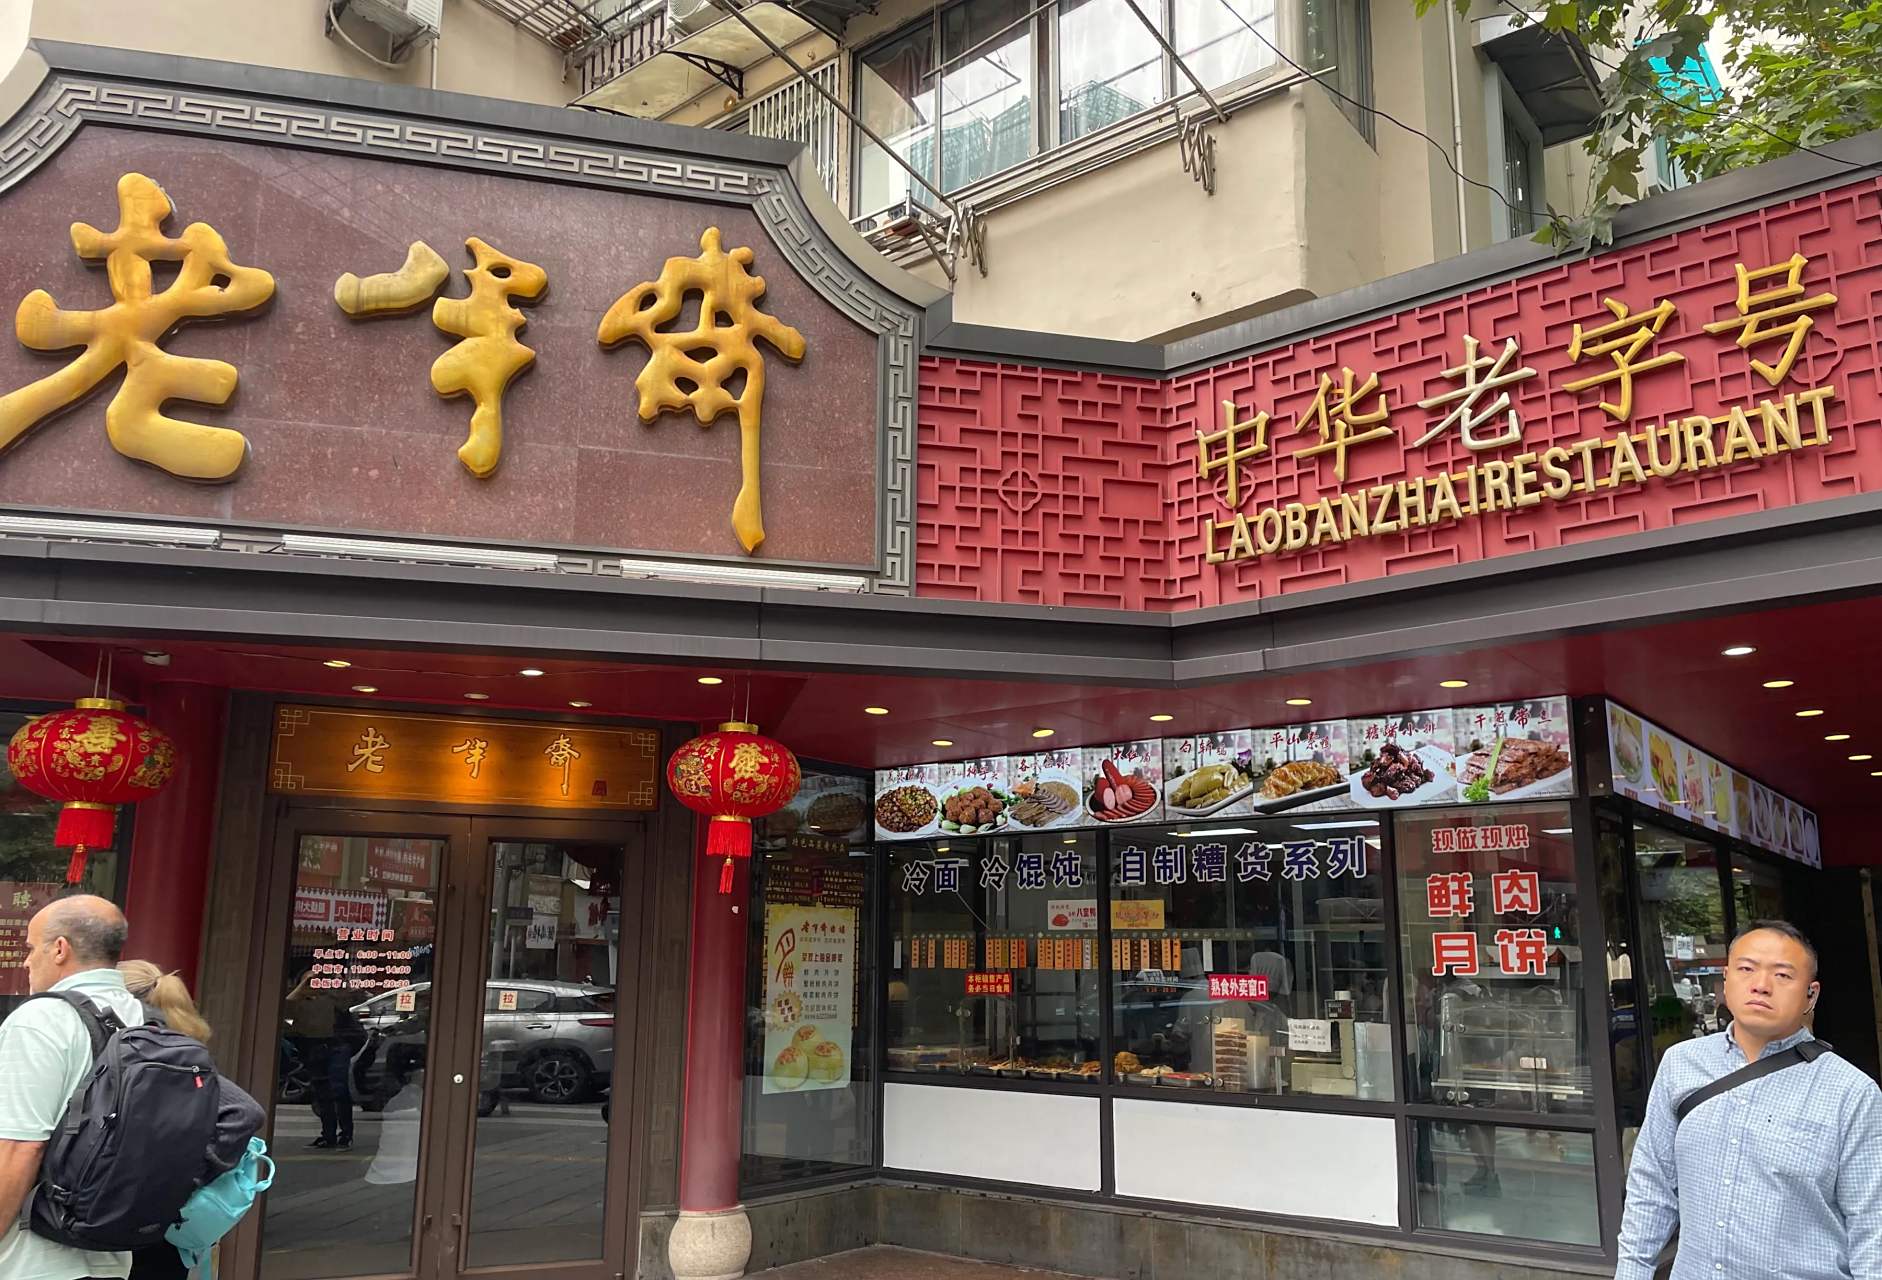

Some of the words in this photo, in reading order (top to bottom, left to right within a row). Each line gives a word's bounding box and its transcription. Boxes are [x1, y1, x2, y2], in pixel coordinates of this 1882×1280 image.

[1197, 252, 1838, 509] 中华老字号
[1432, 823, 1529, 853] 现做现烘
[902, 858, 960, 895] 冷面
[980, 850, 1083, 891] 冷馄饨
[1120, 835, 1367, 886] 自制糟货系列
[1425, 869, 1541, 918] 鲜肉
[337, 928, 395, 941] 营业时间
[1432, 929, 1548, 977] 月饼
[400, 992, 413, 1004] 拉
[503, 992, 515, 1003] 拉
[1210, 978, 1268, 997] 熟食外卖窗口
